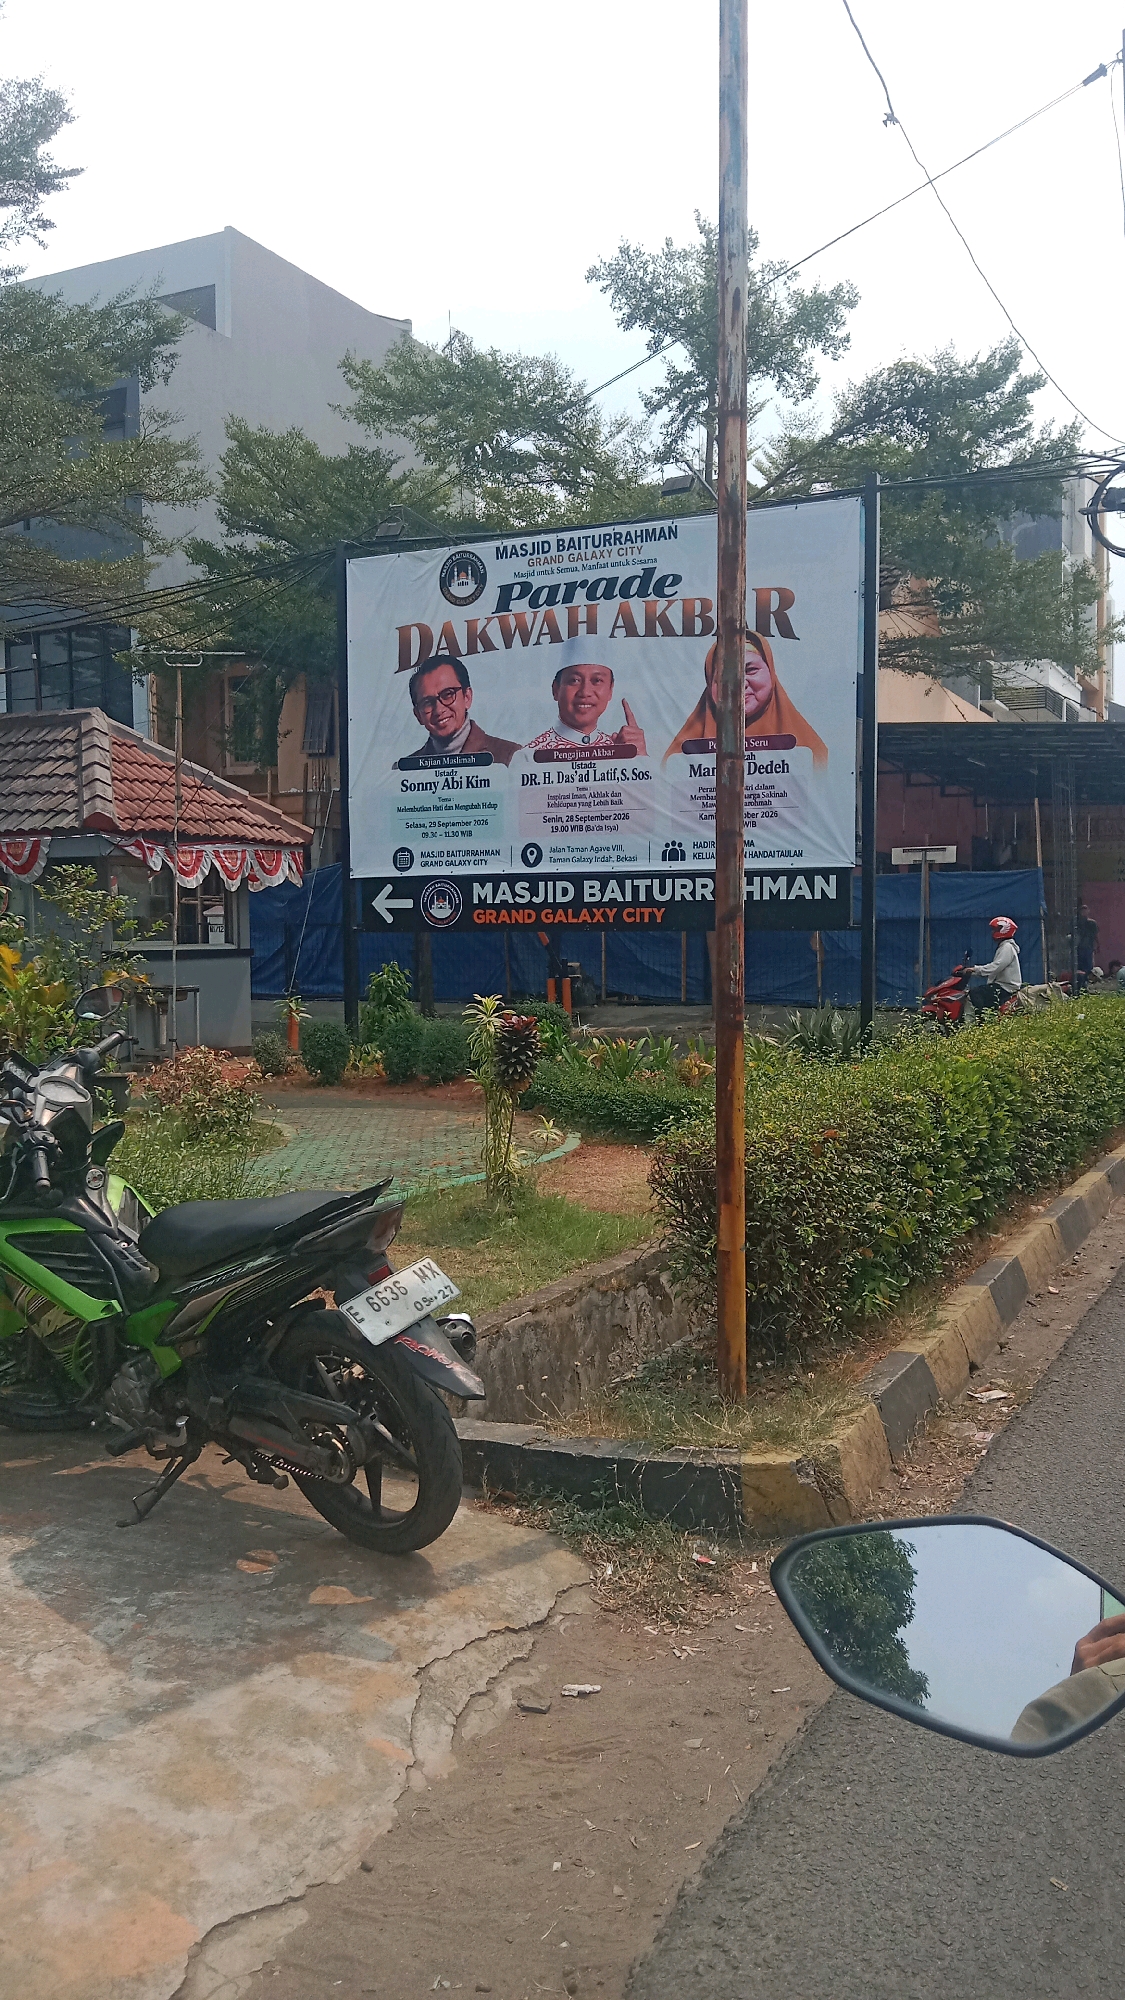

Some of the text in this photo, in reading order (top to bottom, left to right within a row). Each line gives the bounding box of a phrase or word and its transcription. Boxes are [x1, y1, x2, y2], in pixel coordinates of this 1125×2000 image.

[496, 525, 678, 560] MASJID BAITURRAHMAN
[528, 546, 643, 567] GRAND GALAXY CITY
[514, 557, 657, 580] Masjid untuk Semua, Manfaat untuk Sesama
[492, 567, 683, 615] Parade
[394, 587, 800, 674] DAKWAH AKBR
[750, 739, 768, 748] Seru
[554, 748, 615, 761] Pengajian Akbar
[419, 758, 441, 768] Kajian
[572, 762, 597, 770] Ustadz
[747, 760, 790, 776] Dedeh
[435, 769, 458, 778] Ustadz
[521, 774, 541, 786] DR.
[543, 772, 554, 784] H.
[557, 770, 590, 784] Das'ad
[632, 768, 652, 781] Sos.
[401, 775, 490, 794] Sonny Abi Kim
[547, 793, 571, 801] Inspirasi
[588, 791, 610, 799] Akhlak
[547, 801, 578, 809] Kehidupan
[542, 812, 630, 824] Senin, 28 September 2026
[760, 811, 778, 819] 2026
[438, 820, 472, 829] September
[551, 825, 569, 833] 19.00
[570, 824, 584, 832] WIB
[589, 845, 611, 854] Agave
[693, 841, 716, 850] HADIR
[421, 849, 500, 859] MASJID BAITURRAHMAN
[693, 852, 716, 860] KELUA
[748, 850, 776, 859] HANDAI
[776, 850, 803, 858] TAULAN
[421, 860, 444, 868] GRAND
[549, 856, 571, 864] Taman
[571, 856, 594, 864] Galaxy
[473, 874, 837, 906] MASJID BAITURRHMAN
[473, 909, 537, 924] GRAND
[540, 908, 618, 924] GALAXY
[623, 907, 666, 923] CITY
[346, 1262, 442, 1324] E 6636 MX
